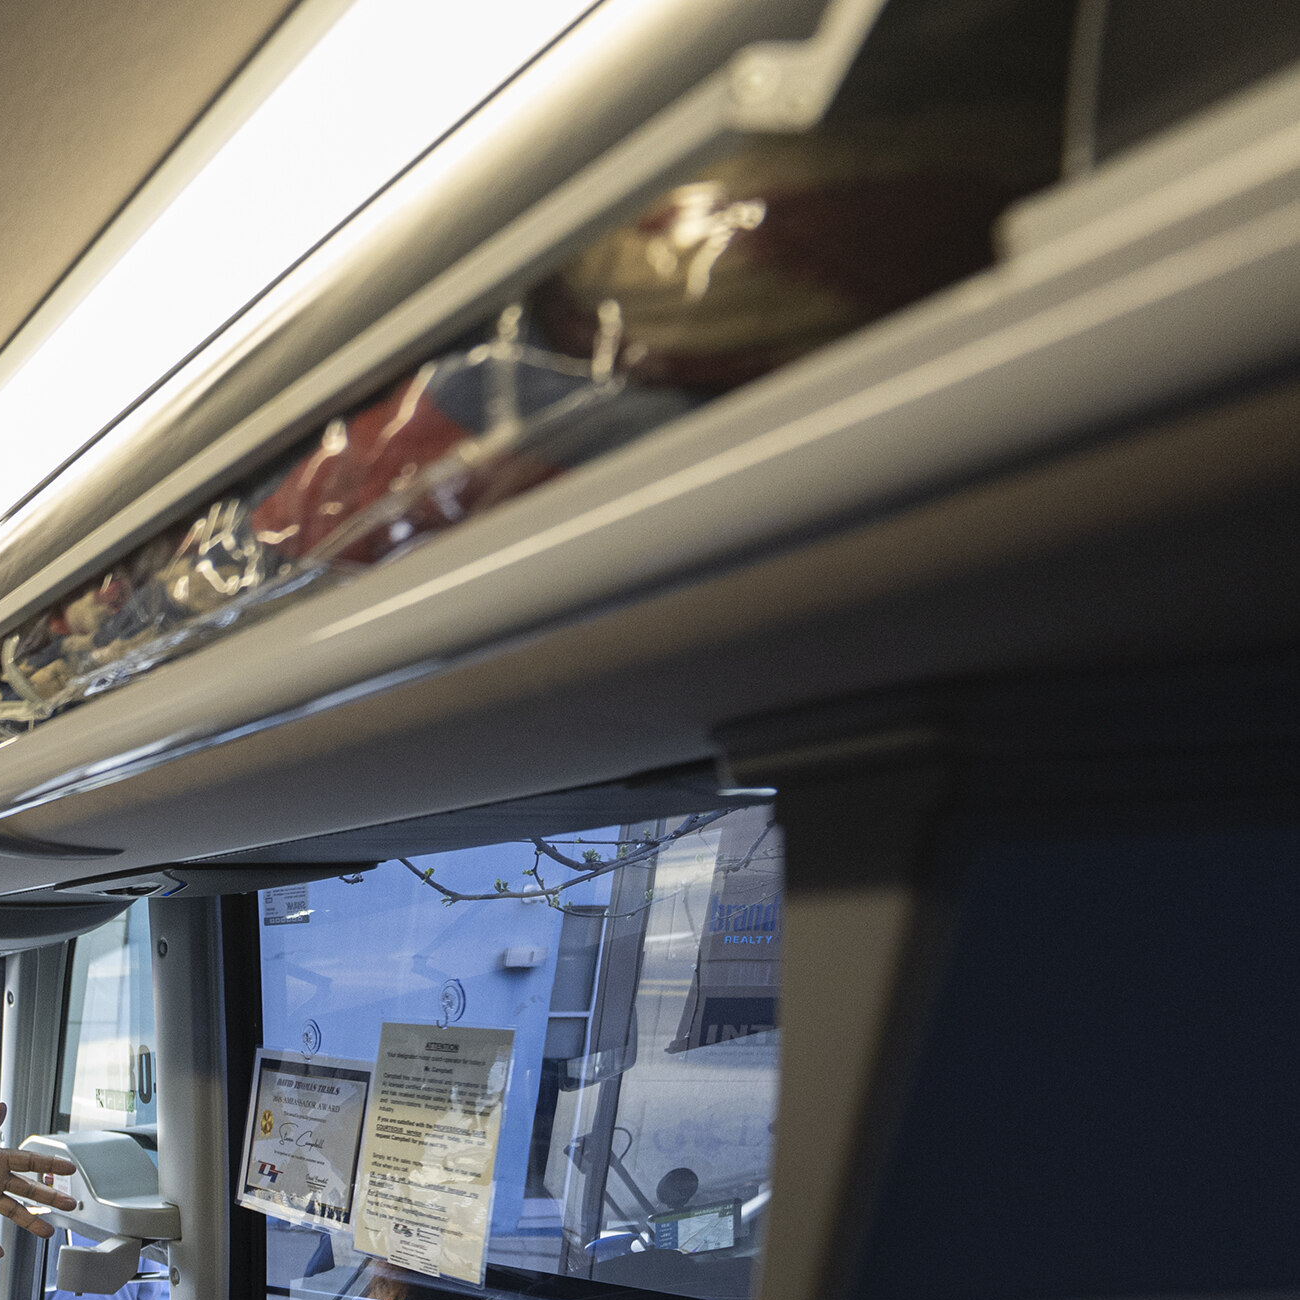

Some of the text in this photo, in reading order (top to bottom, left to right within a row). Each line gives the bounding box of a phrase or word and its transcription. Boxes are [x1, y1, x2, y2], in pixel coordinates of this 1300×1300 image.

[709, 894, 780, 932] brand
[724, 936, 773, 945] REALTY
[425, 1042, 459, 1053] ATTENTION
[276, 1078, 294, 1087] DAVID
[294, 1080, 317, 1092] THOMAS
[318, 1102, 341, 1113] AWARD
